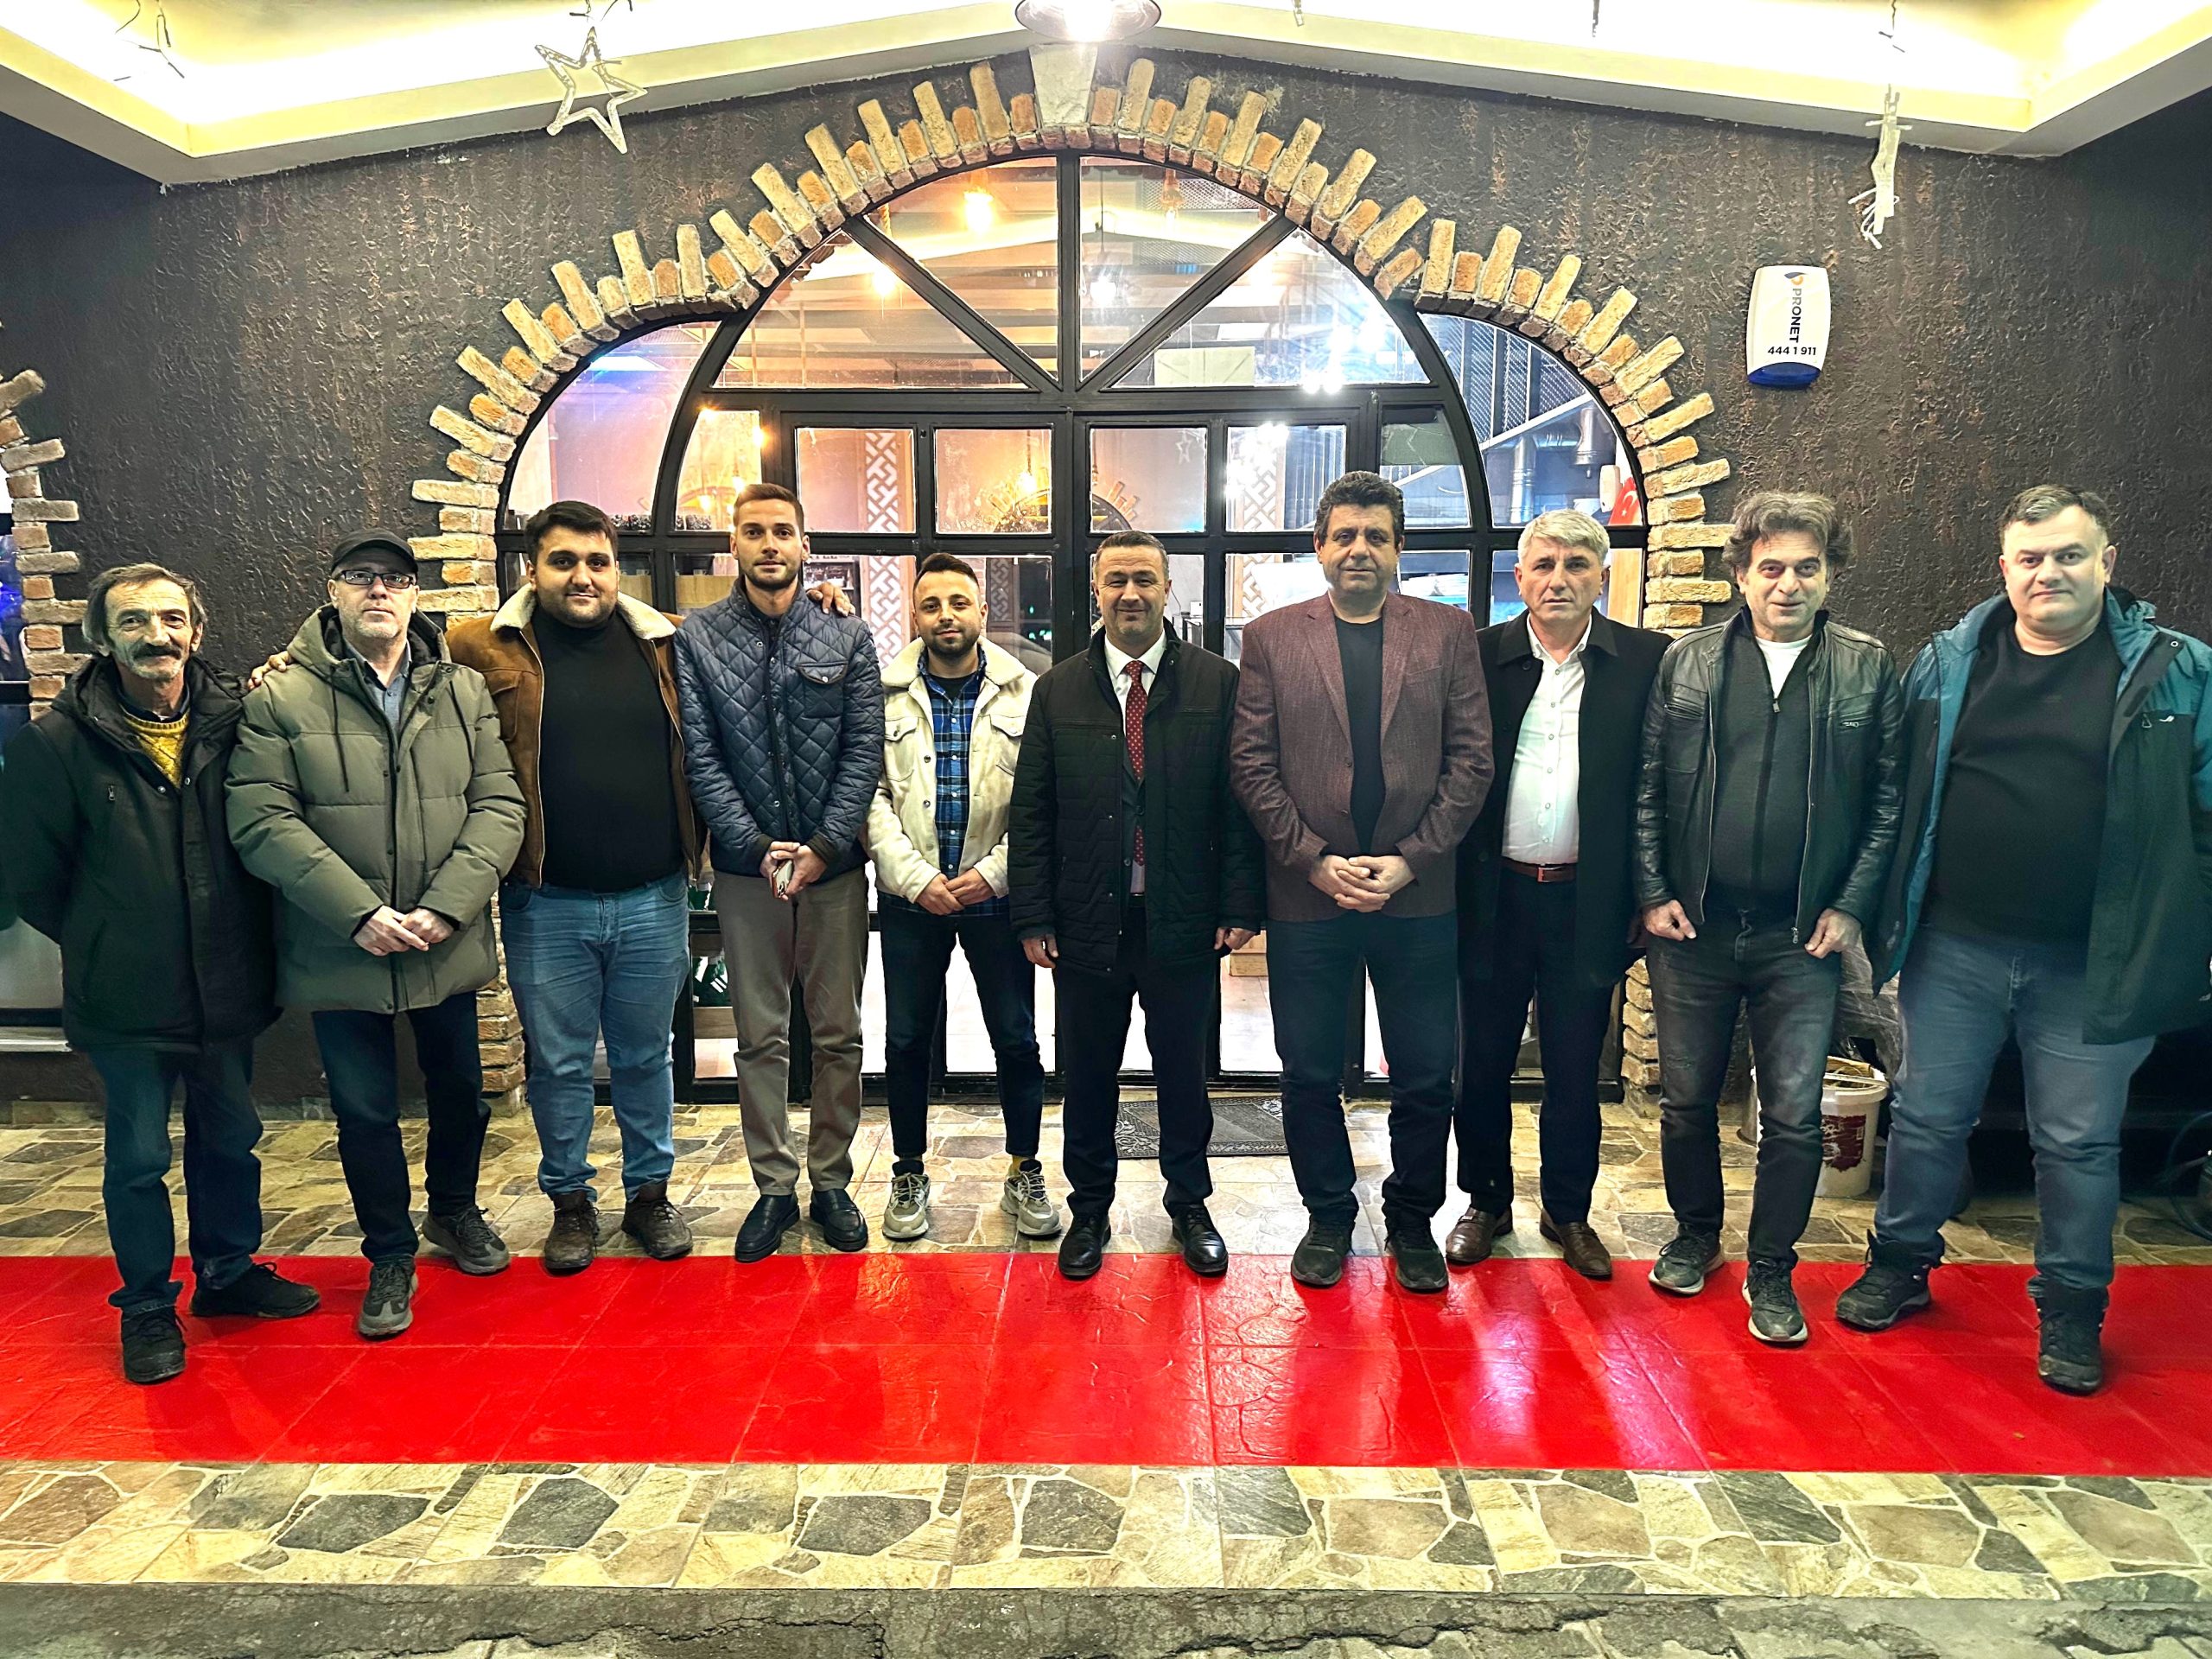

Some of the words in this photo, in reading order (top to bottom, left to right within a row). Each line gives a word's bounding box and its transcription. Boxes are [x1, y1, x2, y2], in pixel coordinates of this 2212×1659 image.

[1789, 288, 1802, 343] PRONET
[1767, 346, 1789, 355] 444
[1793, 346, 1797, 355] 1
[1801, 346, 1816, 355] 911
